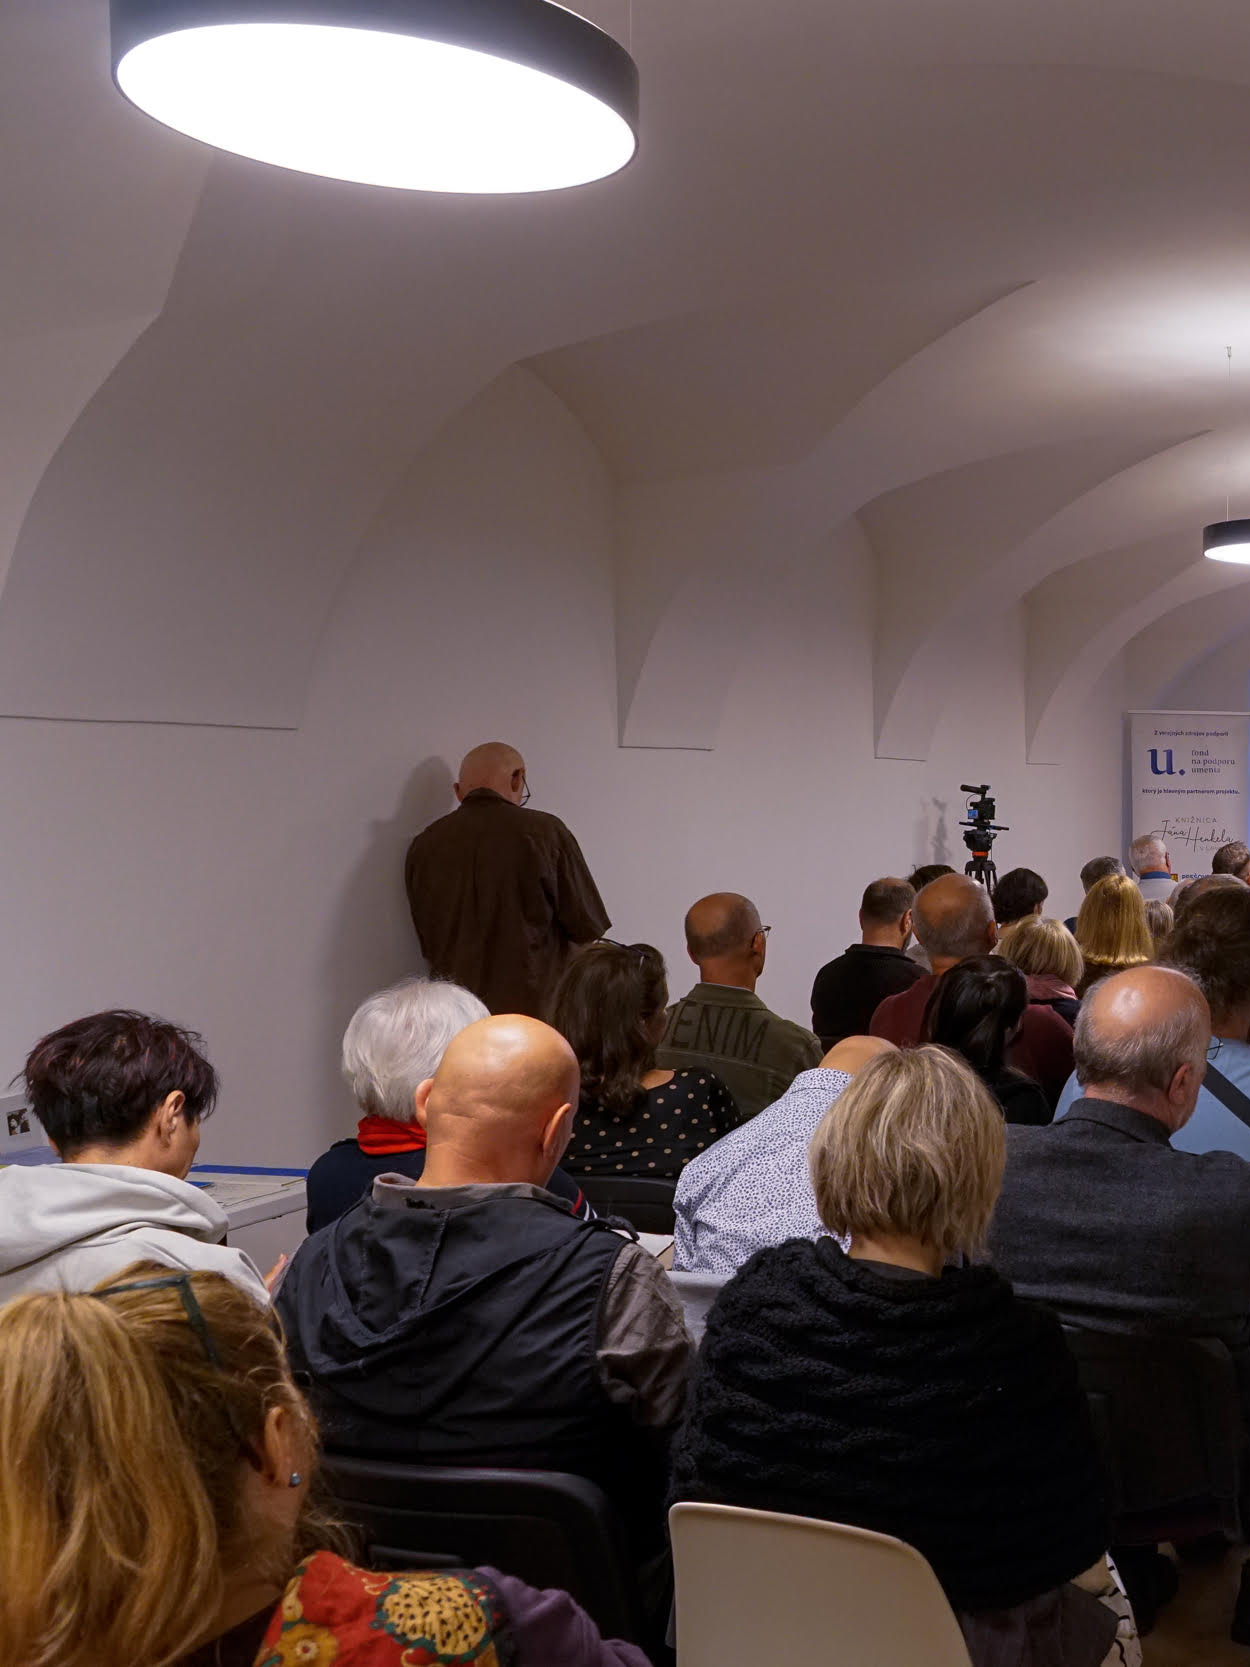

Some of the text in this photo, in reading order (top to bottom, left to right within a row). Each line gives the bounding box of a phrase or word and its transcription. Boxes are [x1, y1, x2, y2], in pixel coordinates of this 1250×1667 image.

[1203, 758, 1236, 766] podporu
[1175, 816, 1218, 824] KNIŽNICA
[1151, 819, 1188, 841] Jána
[661, 1001, 770, 1062] ENIM
